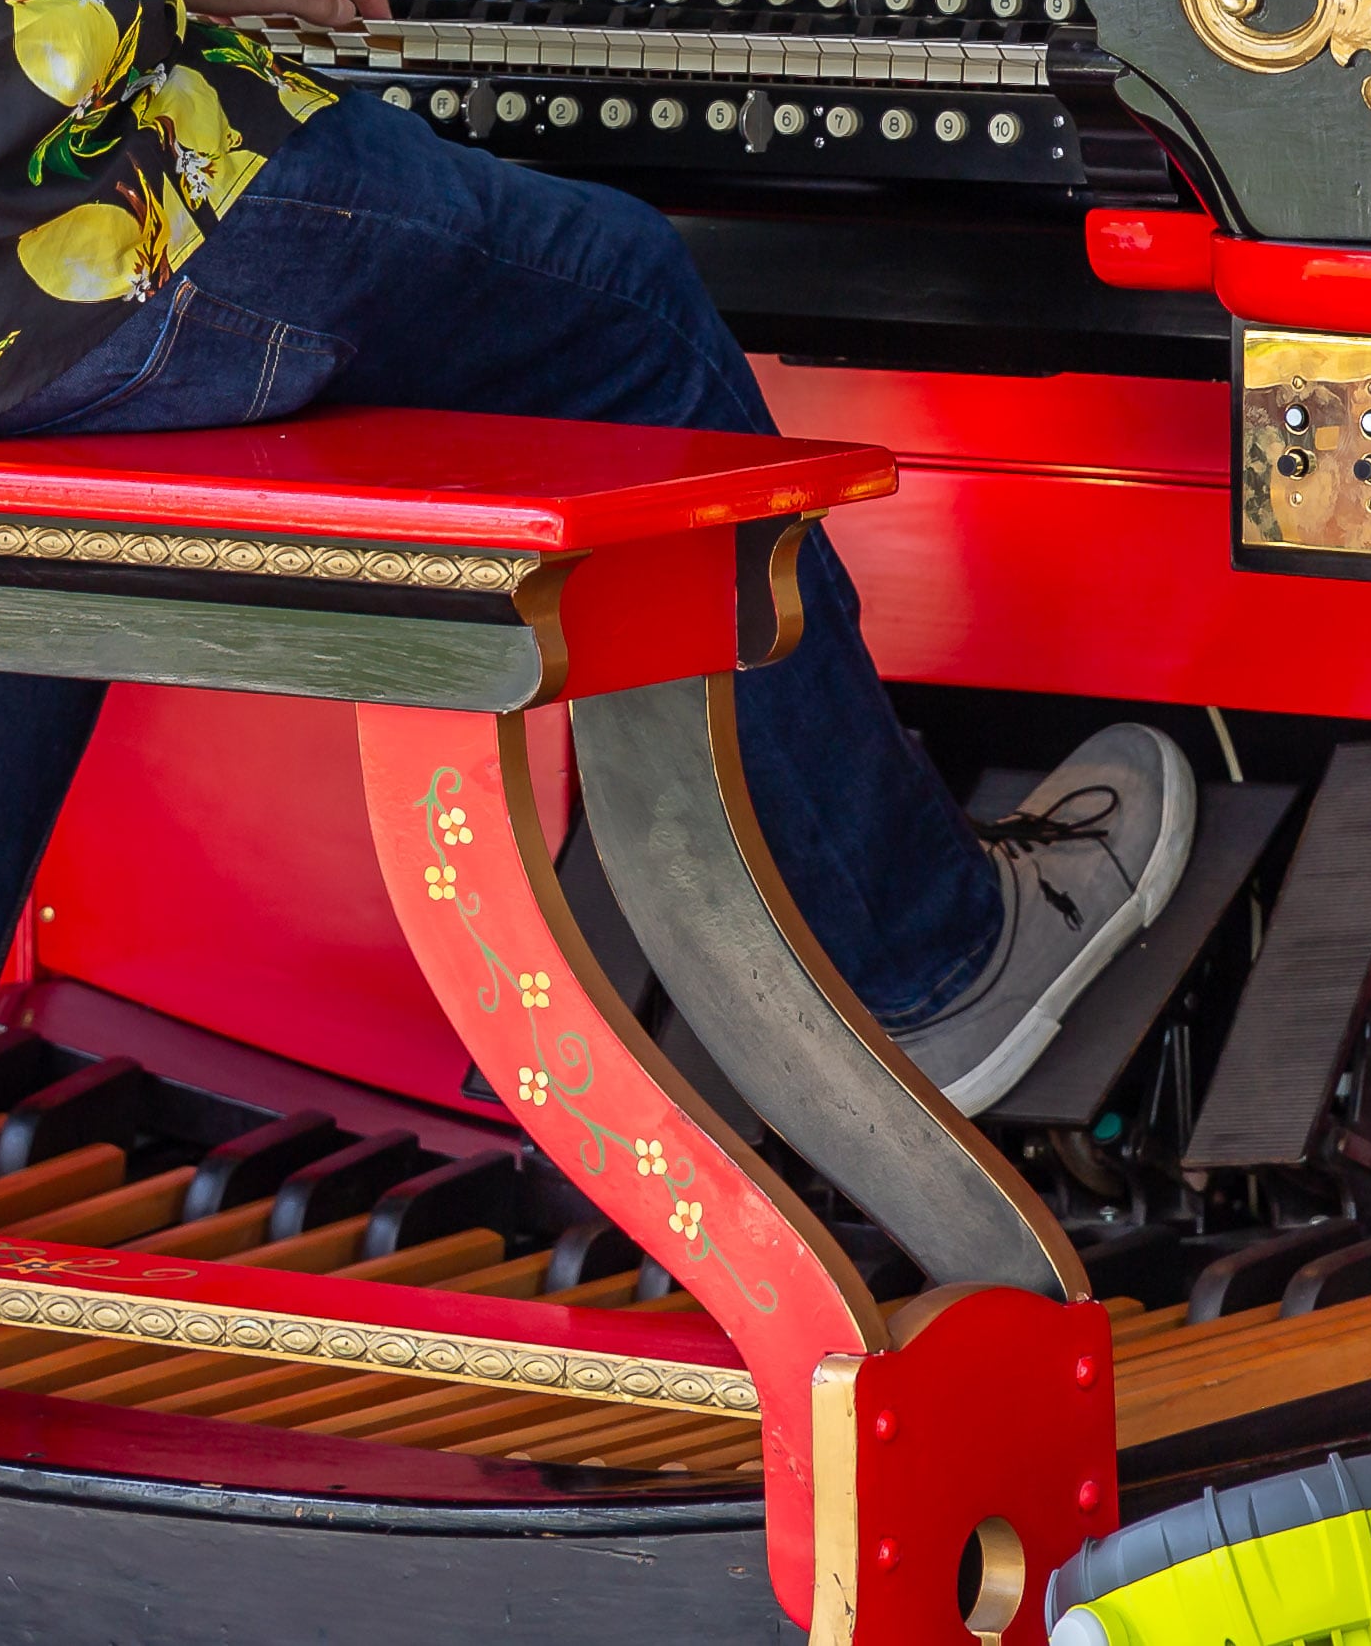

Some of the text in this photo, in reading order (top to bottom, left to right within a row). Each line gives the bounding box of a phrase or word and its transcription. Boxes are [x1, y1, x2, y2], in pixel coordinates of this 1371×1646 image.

[505, 99, 514, 115] 1
[555, 104, 566, 119] 2
[608, 106, 619, 121] 3
[658, 107, 670, 121] 4
[716, 109, 725, 123] 5
[782, 112, 791, 127] 6
[835, 114, 844, 129] 7
[889, 117, 900, 133] 8
[944, 118, 953, 134] 9
[995, 122, 1011, 137] 10
